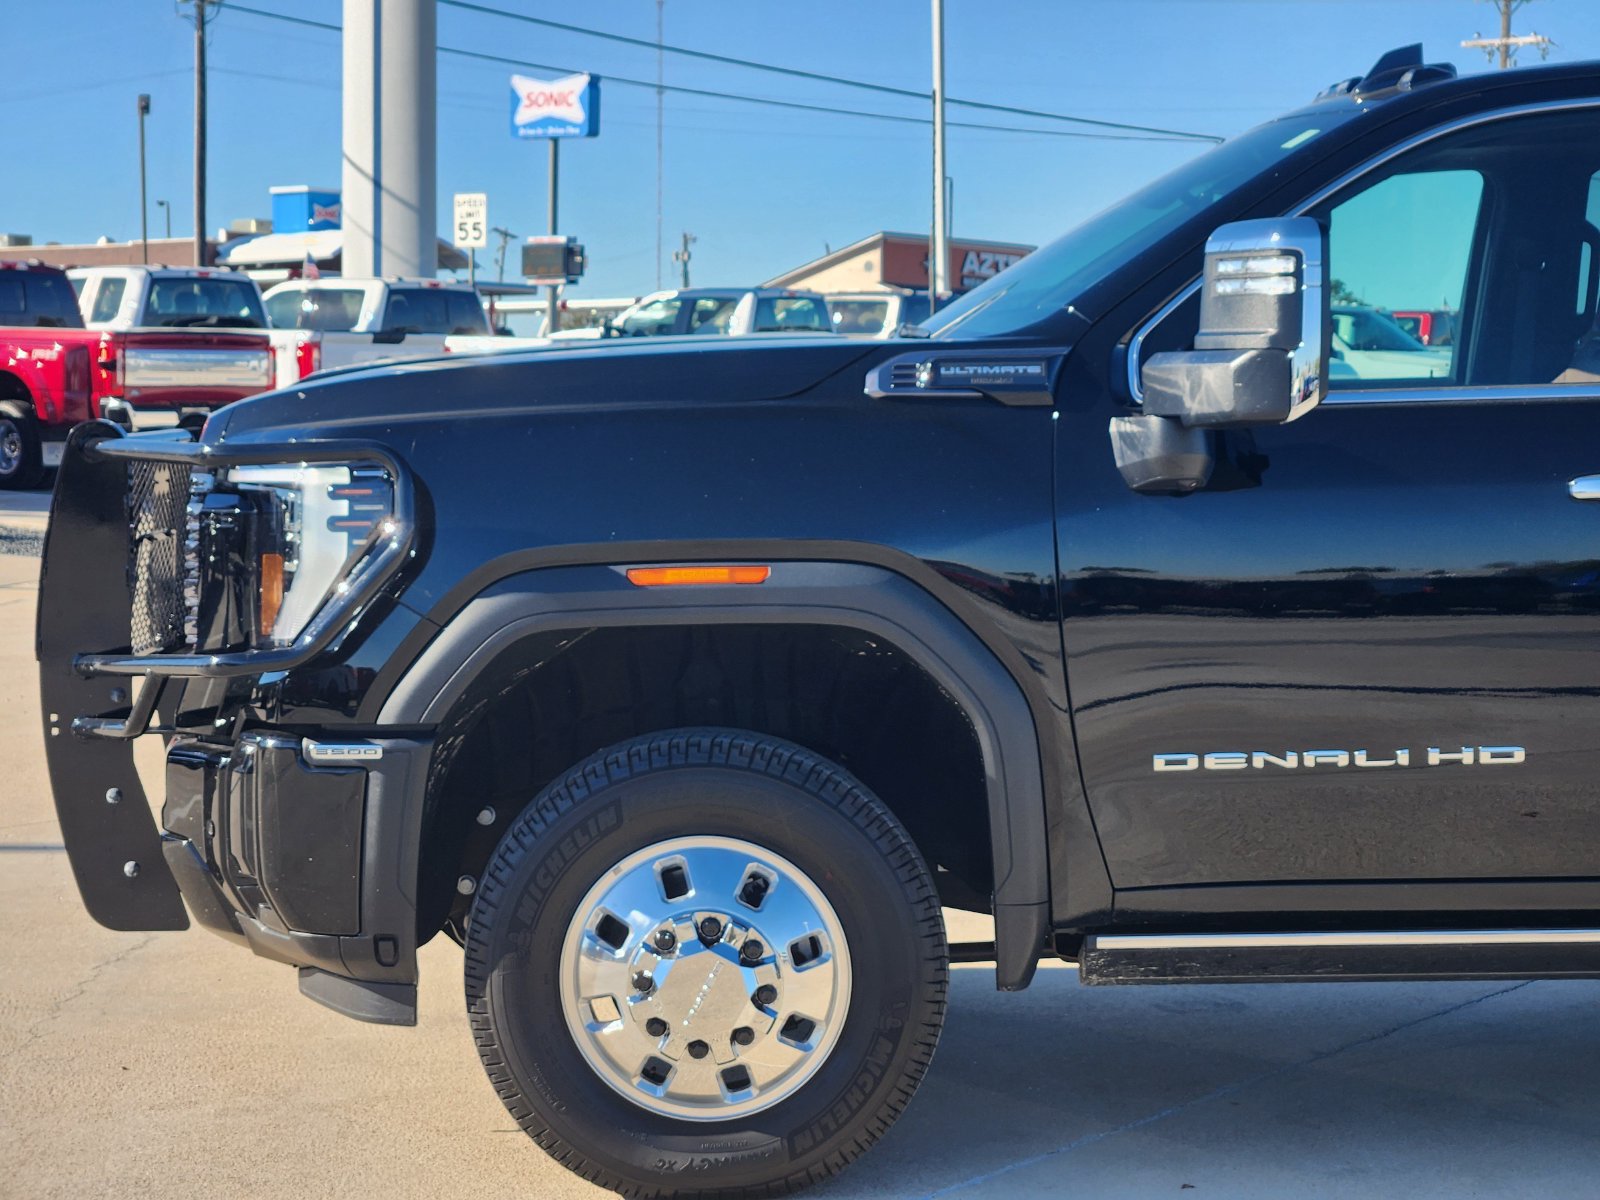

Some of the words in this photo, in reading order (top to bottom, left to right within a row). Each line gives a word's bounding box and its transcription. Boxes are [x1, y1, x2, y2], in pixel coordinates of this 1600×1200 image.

[524, 91, 575, 108] SONIC
[458, 222, 483, 241] 55
[940, 365, 1042, 375] ULTIMATE
[1152, 748, 1411, 772] DENALI
[1427, 745, 1526, 765] HD
[515, 803, 619, 927] MICHELIN
[793, 1033, 895, 1155] MICHELIN
